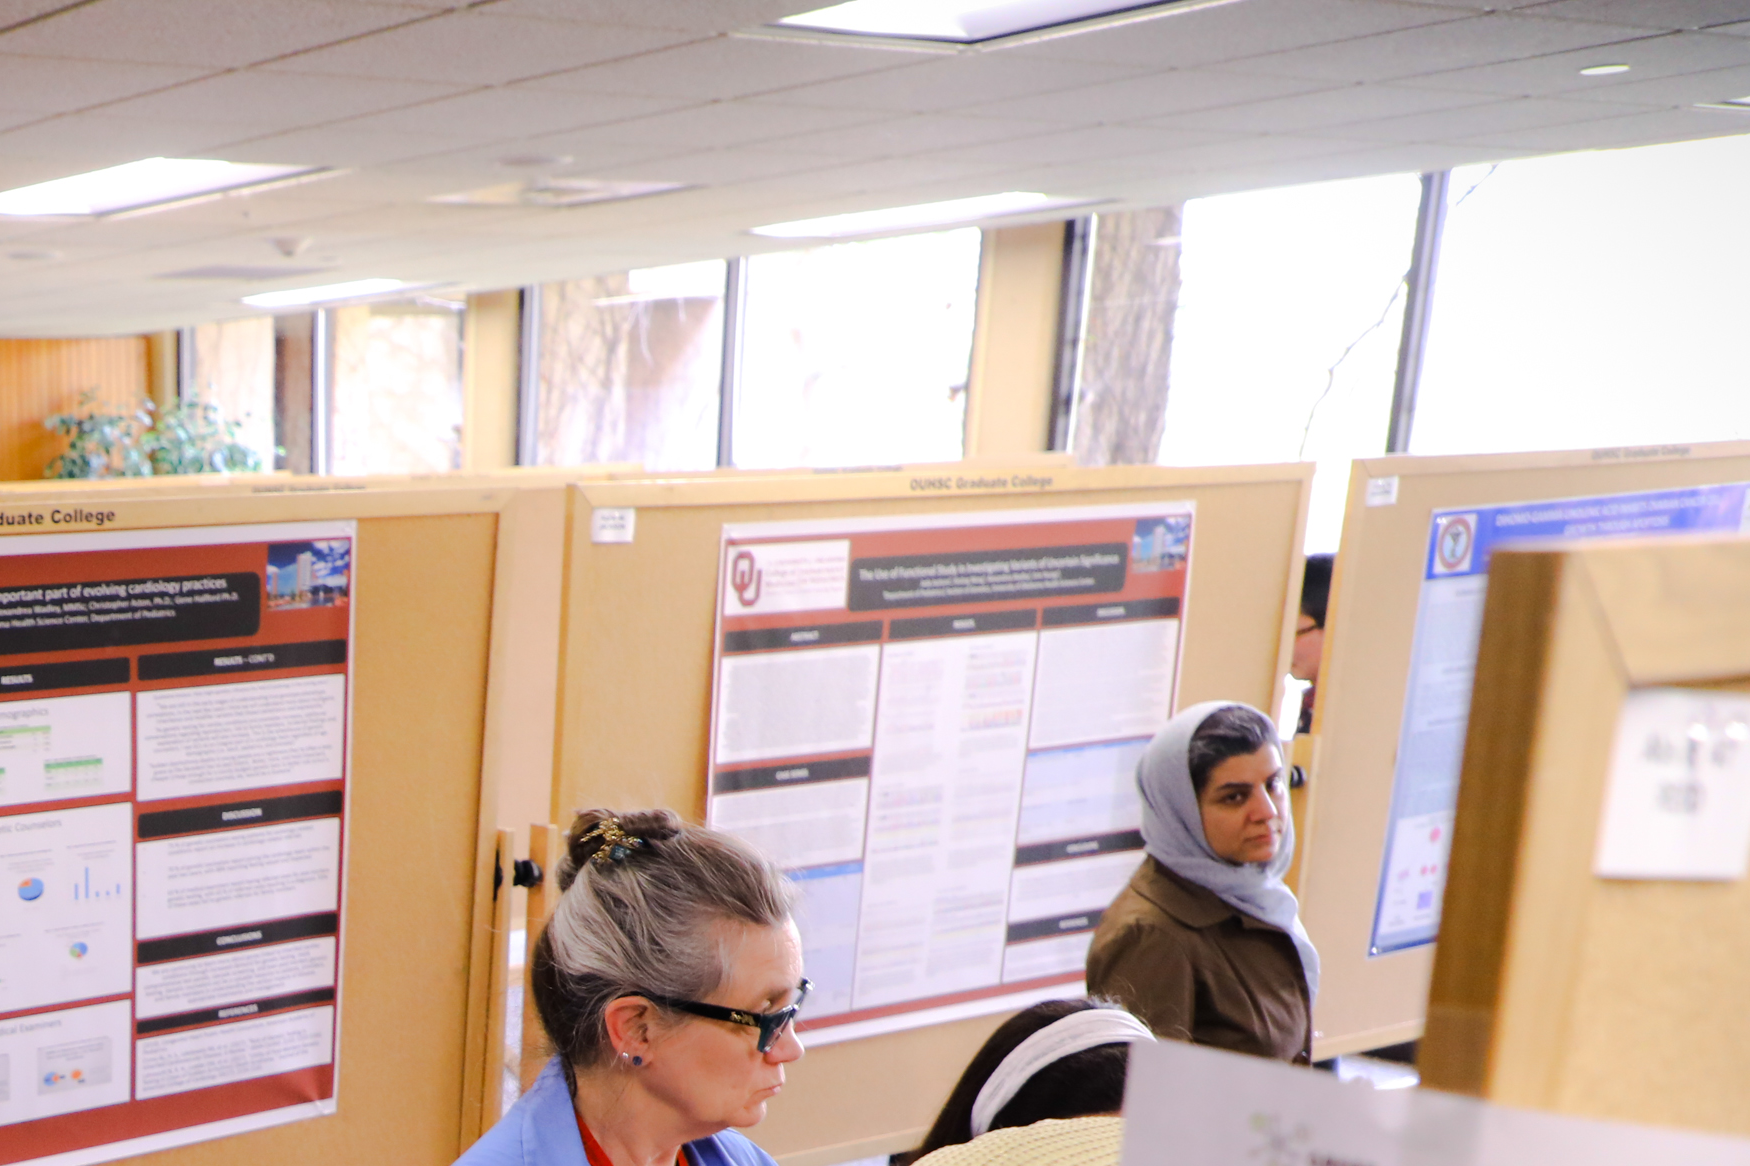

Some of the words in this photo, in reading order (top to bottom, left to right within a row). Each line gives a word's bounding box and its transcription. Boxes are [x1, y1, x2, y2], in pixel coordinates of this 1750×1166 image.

[910, 477, 952, 490] OUHSC
[956, 475, 1008, 489] Graduate
[1011, 474, 1053, 488] College
[51, 509, 116, 525] College
[45, 585, 68, 602] part
[69, 584, 80, 598] of
[82, 581, 127, 599] evolving
[127, 578, 180, 596] cardiology
[181, 575, 227, 592] practices
[19, 1018, 63, 1033] Examiners
